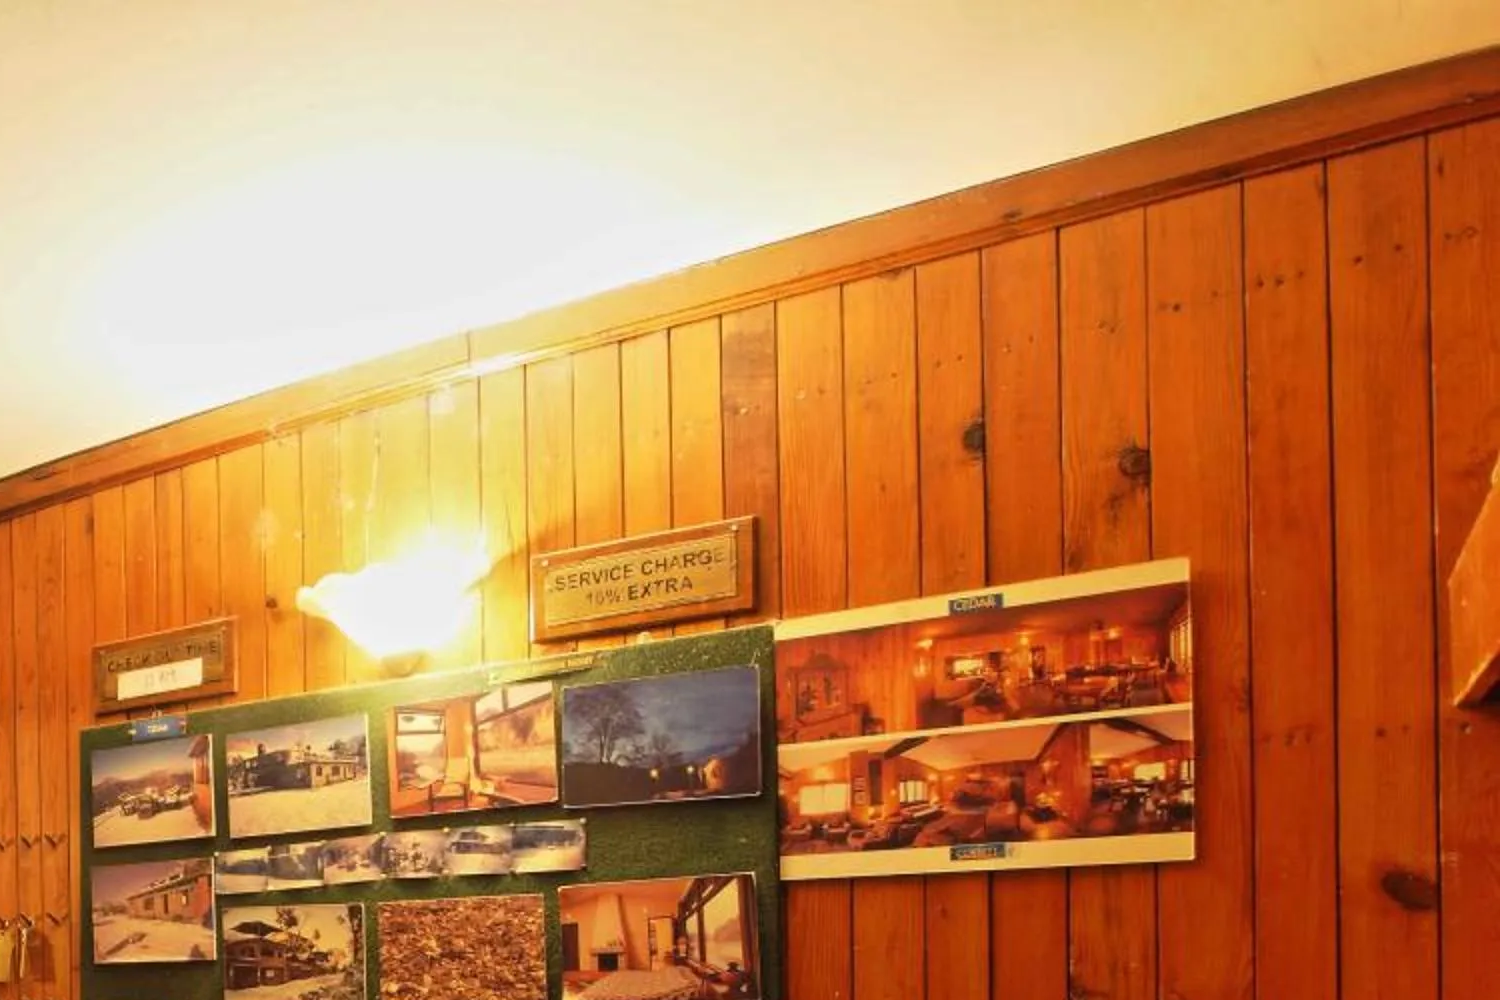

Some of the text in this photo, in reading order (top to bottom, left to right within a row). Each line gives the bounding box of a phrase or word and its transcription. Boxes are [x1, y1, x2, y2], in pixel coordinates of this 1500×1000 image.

[555, 549, 725, 591] SERVICE CHARGE
[628, 576, 693, 600] EXTRA
[107, 654, 149, 673] CHECK
